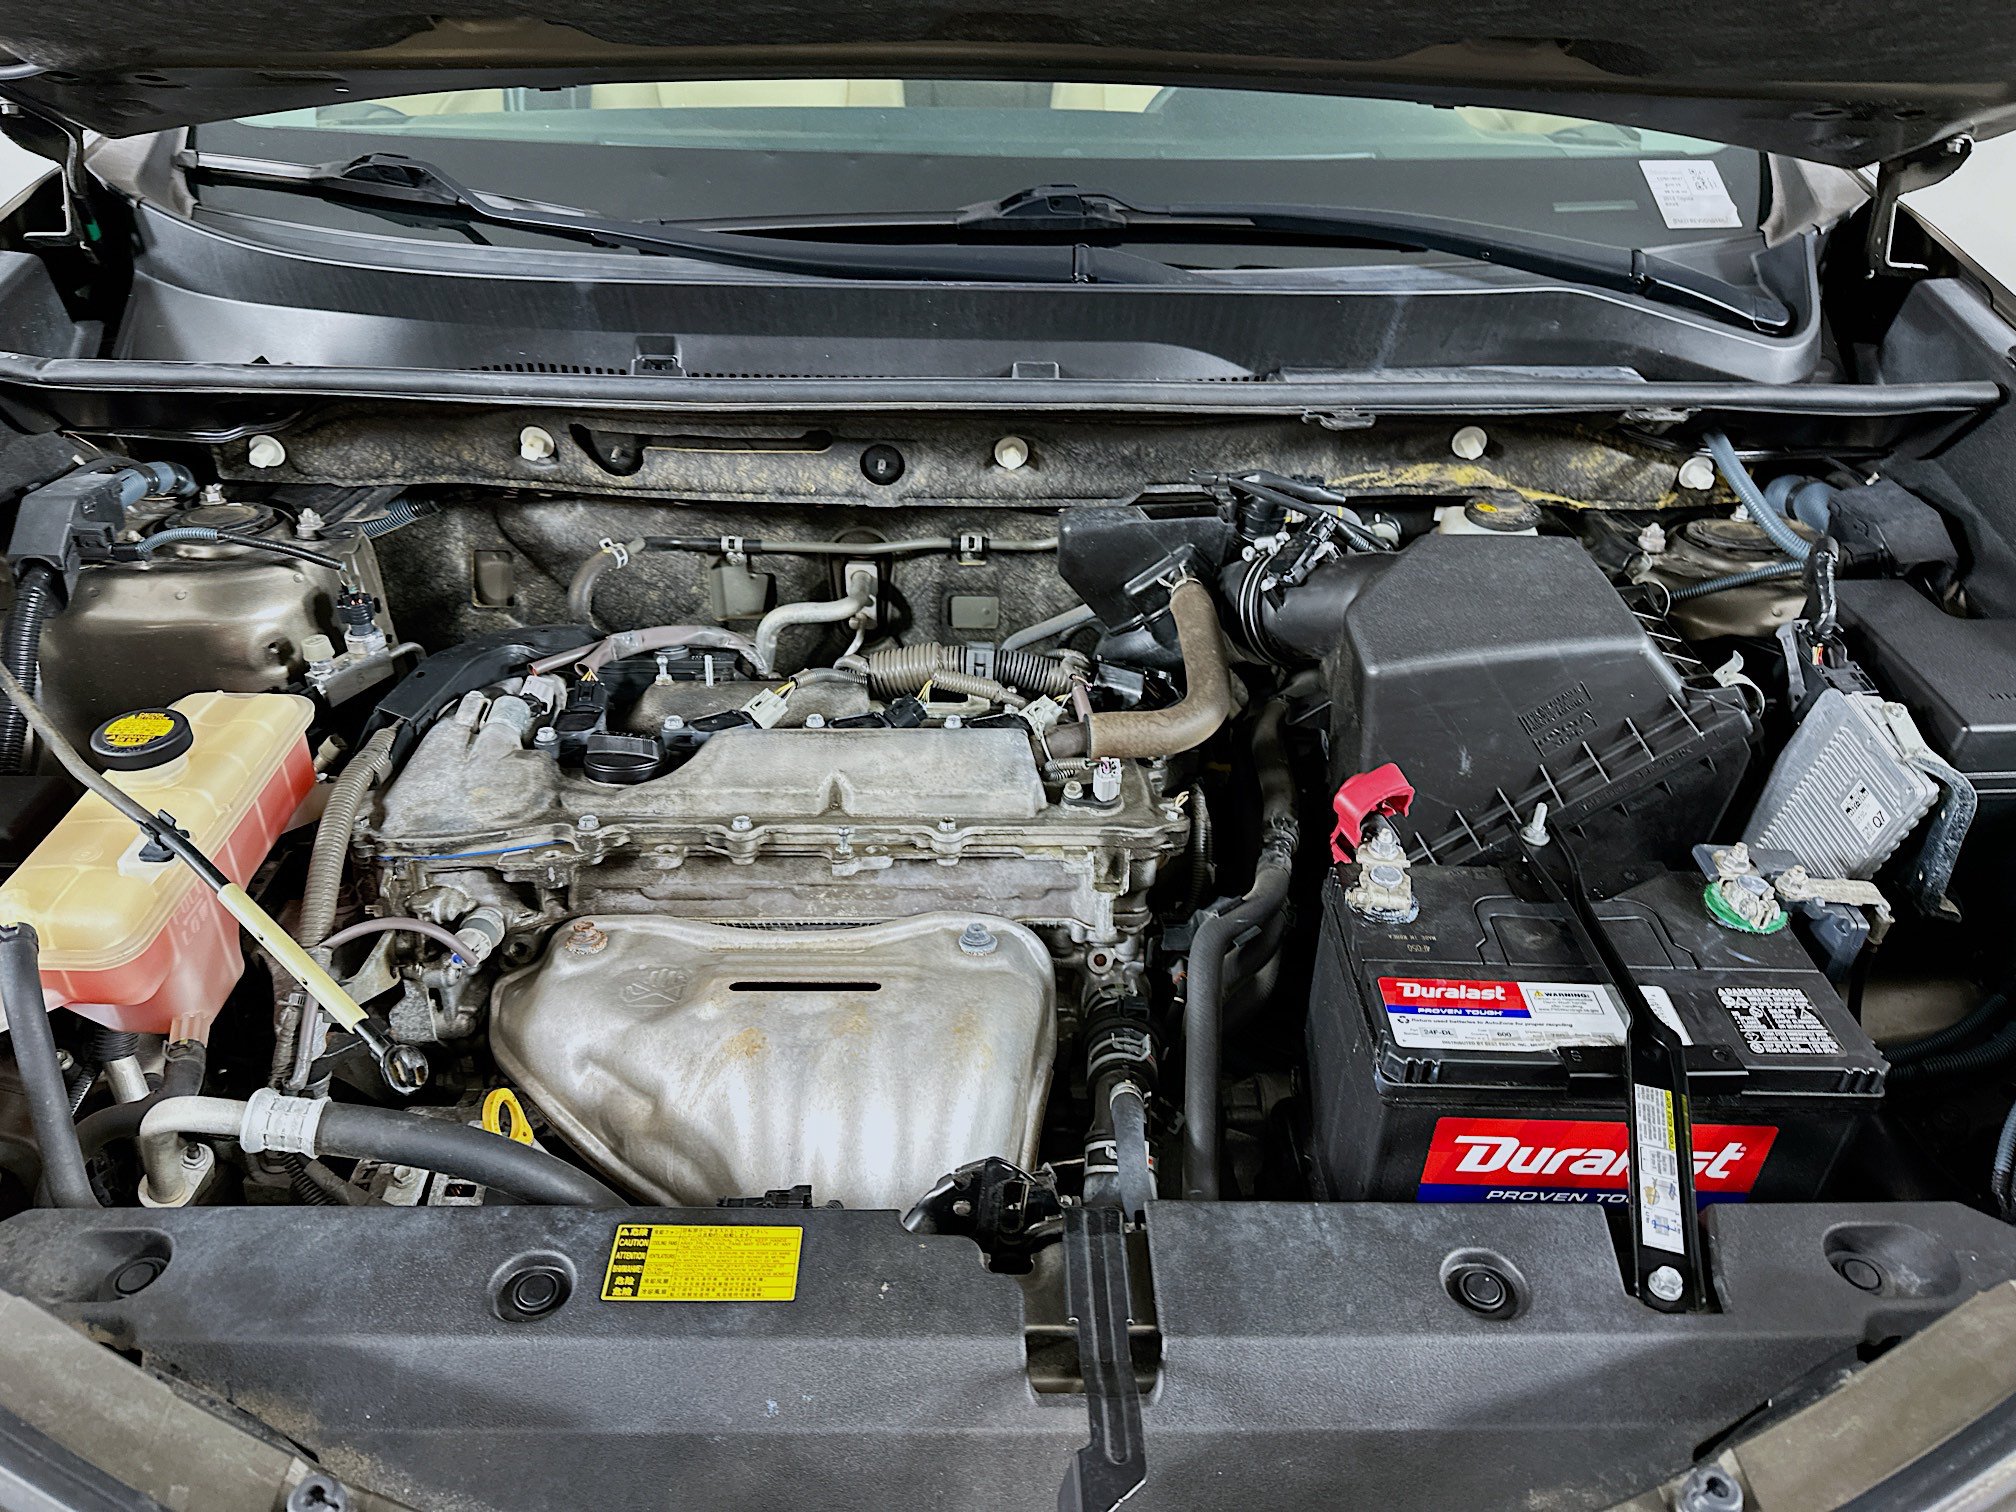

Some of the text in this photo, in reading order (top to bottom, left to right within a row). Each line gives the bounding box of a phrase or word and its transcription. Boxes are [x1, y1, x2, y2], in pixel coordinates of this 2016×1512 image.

[1872, 810, 1885, 828] Q7
[171, 880, 204, 925] FULL
[181, 900, 210, 946] LOW
[1396, 982, 1506, 1001] Duralast
[1418, 1007, 1462, 1015] PROVEN
[1455, 1135, 1745, 1179] Duralst
[1486, 1190, 1588, 1202] PROVEN
[618, 1238, 649, 1247] CAUTION
[615, 1251, 646, 1260] ATTENTION
